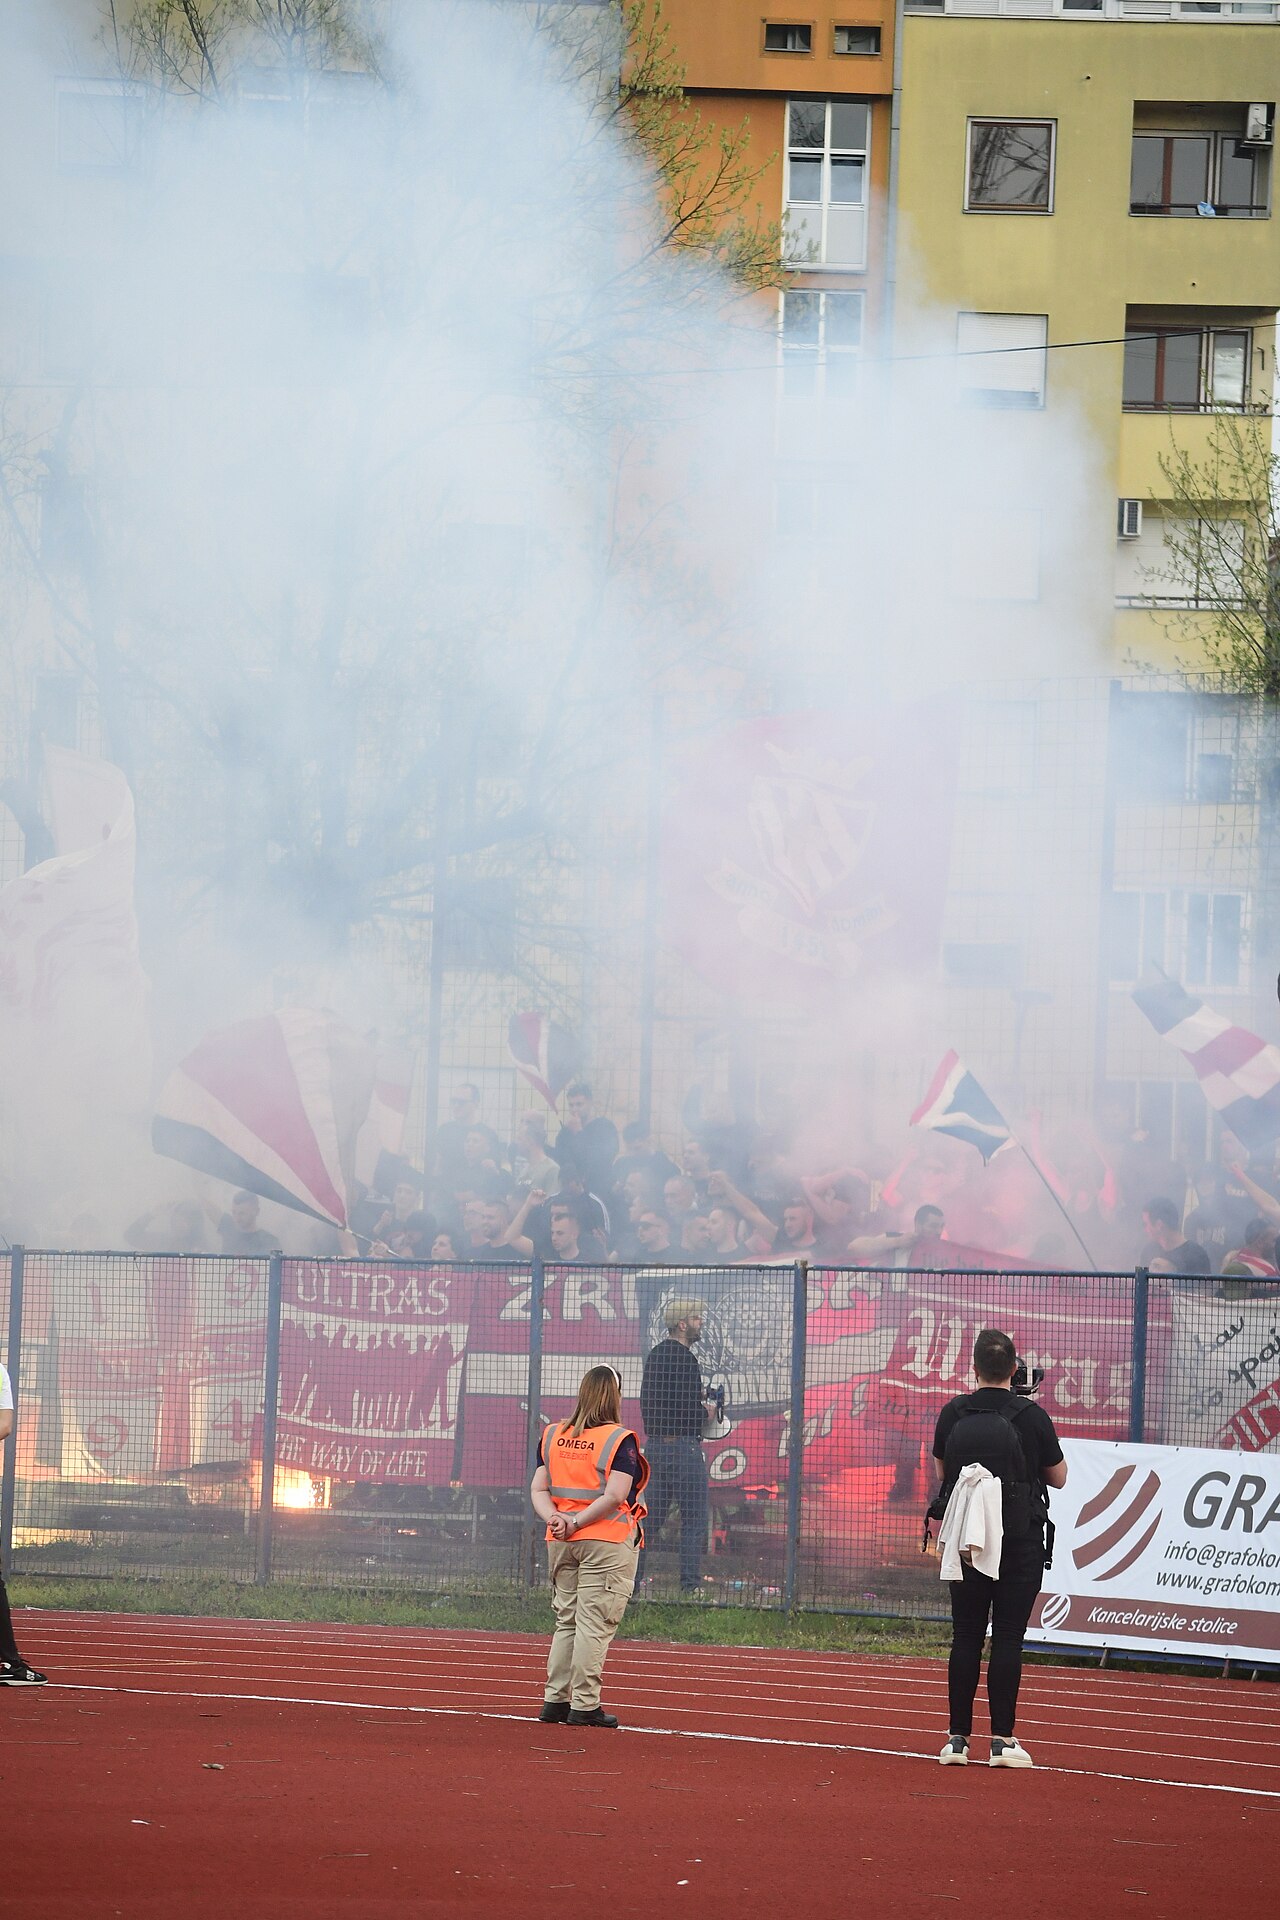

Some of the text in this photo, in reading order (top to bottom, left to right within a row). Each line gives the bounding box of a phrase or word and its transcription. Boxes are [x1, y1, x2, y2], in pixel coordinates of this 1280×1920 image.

[296, 1264, 452, 1317] ULTRAS
[557, 1438, 595, 1451] OMEGA
[311, 1440, 360, 1473] WAY
[359, 1448, 385, 1476] OF
[385, 1449, 429, 1478] LIFE
[1164, 1540, 1280, 1568] info@grafoko
[1156, 1572, 1280, 1596] www.grafokom
[1087, 1607, 1238, 1634] Kancelarijske stolice
